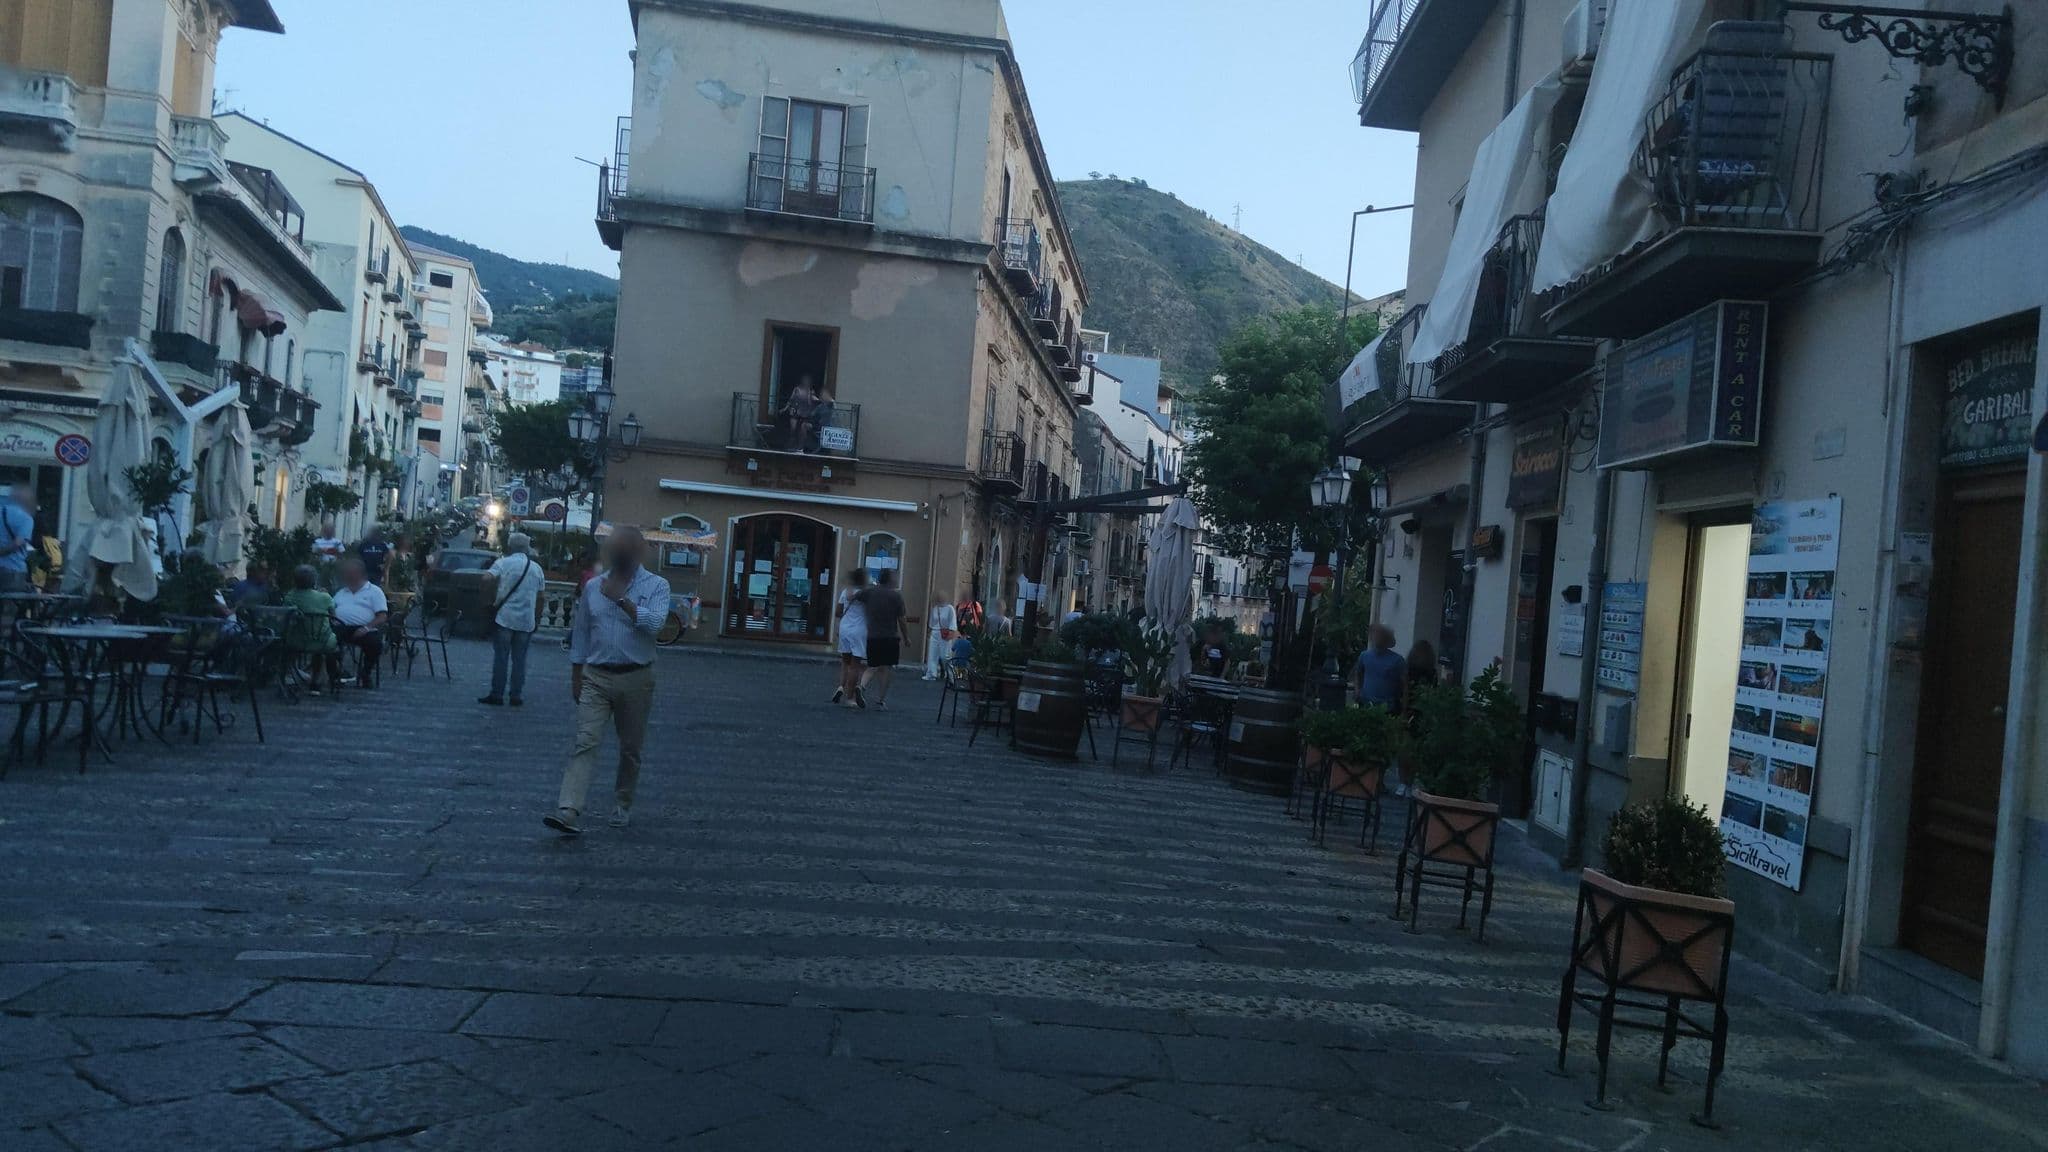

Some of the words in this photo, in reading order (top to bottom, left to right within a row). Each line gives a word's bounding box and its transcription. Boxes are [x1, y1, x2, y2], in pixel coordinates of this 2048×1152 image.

[1736, 310, 1752, 364] RENT
[1731, 373, 1745, 385] A
[1728, 395, 1745, 436] CAR
[1726, 841, 1790, 881] Siciltravel
